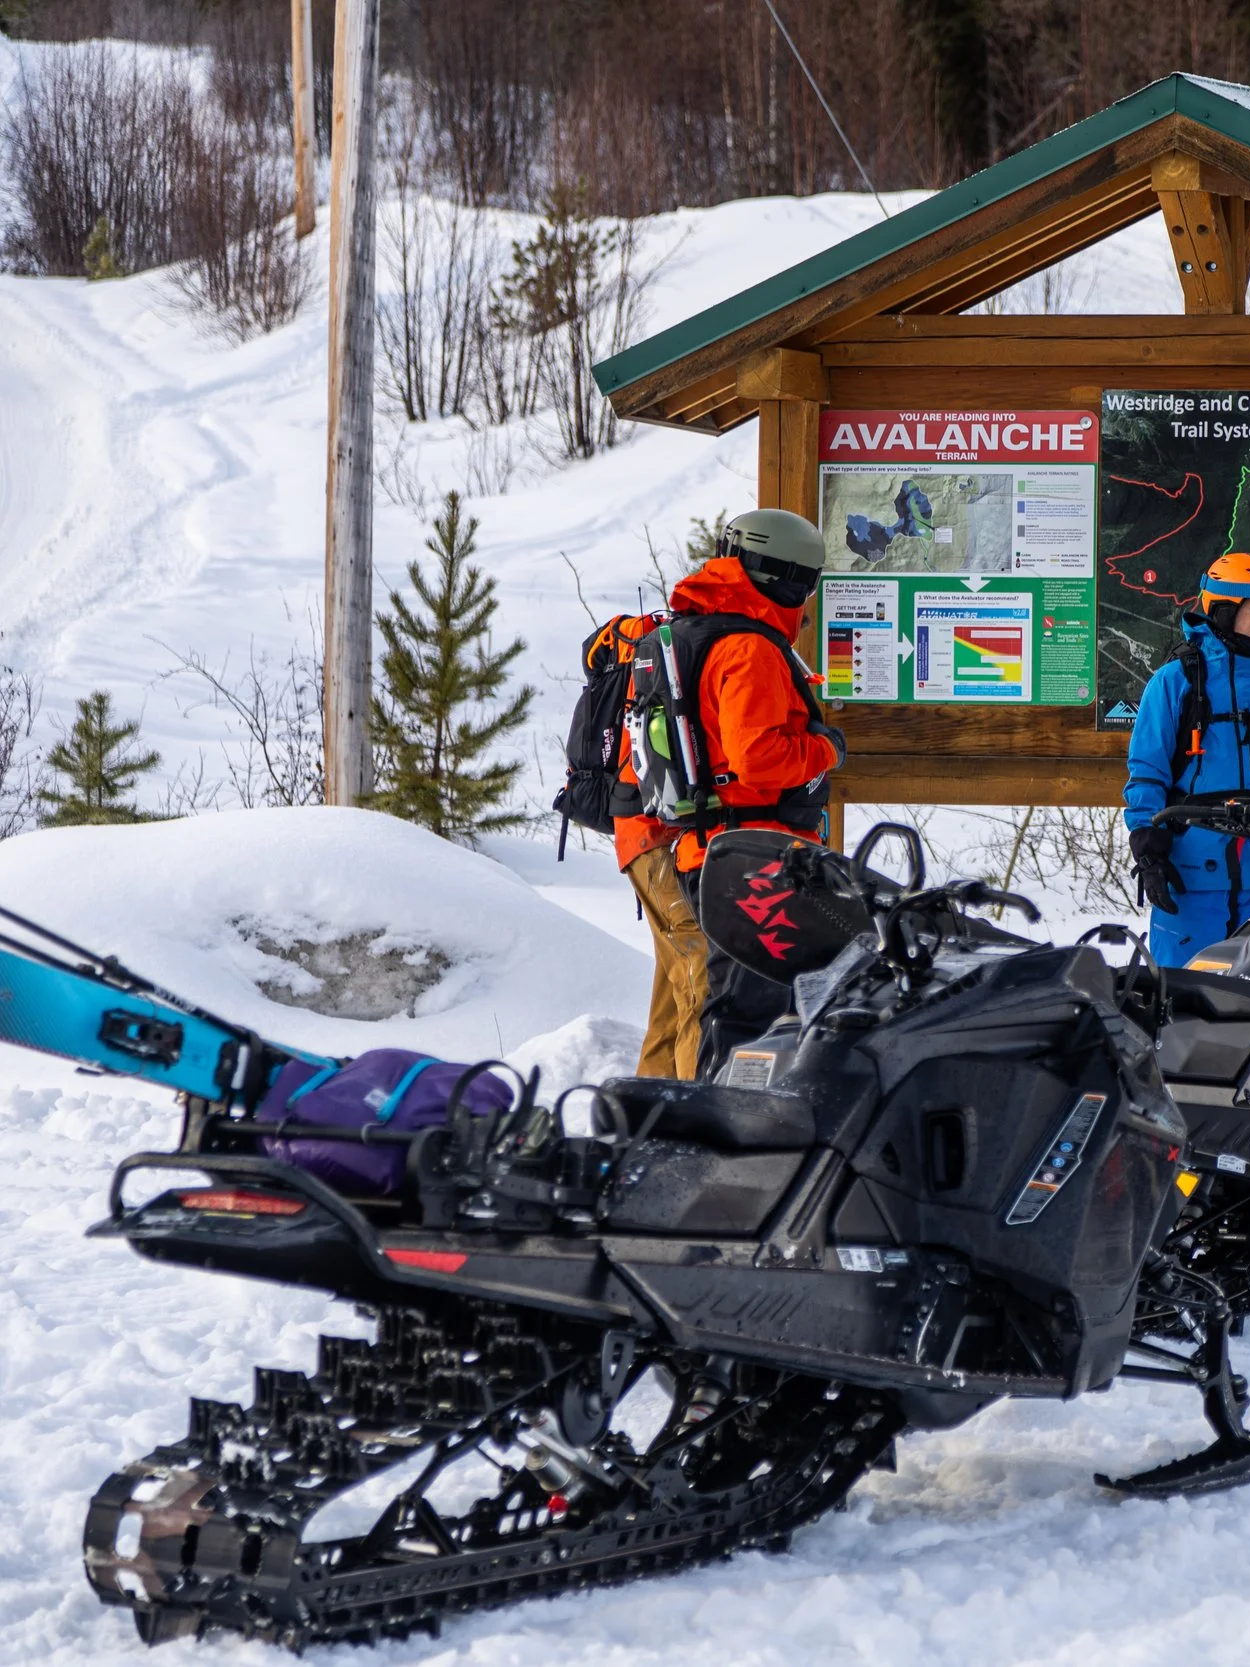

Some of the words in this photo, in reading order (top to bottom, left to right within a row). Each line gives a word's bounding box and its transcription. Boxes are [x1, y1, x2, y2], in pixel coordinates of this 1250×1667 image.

[1107, 394, 1194, 414] Westridge
[1200, 395, 1232, 411] and
[899, 413, 920, 421] YOU
[922, 413, 942, 421] ARE
[944, 413, 989, 421] HEADING
[992, 413, 1016, 421] INTO
[830, 423, 1084, 451] AVALANCHE
[1171, 421, 1208, 438] Trail
[936, 452, 978, 460] TERRAIN
